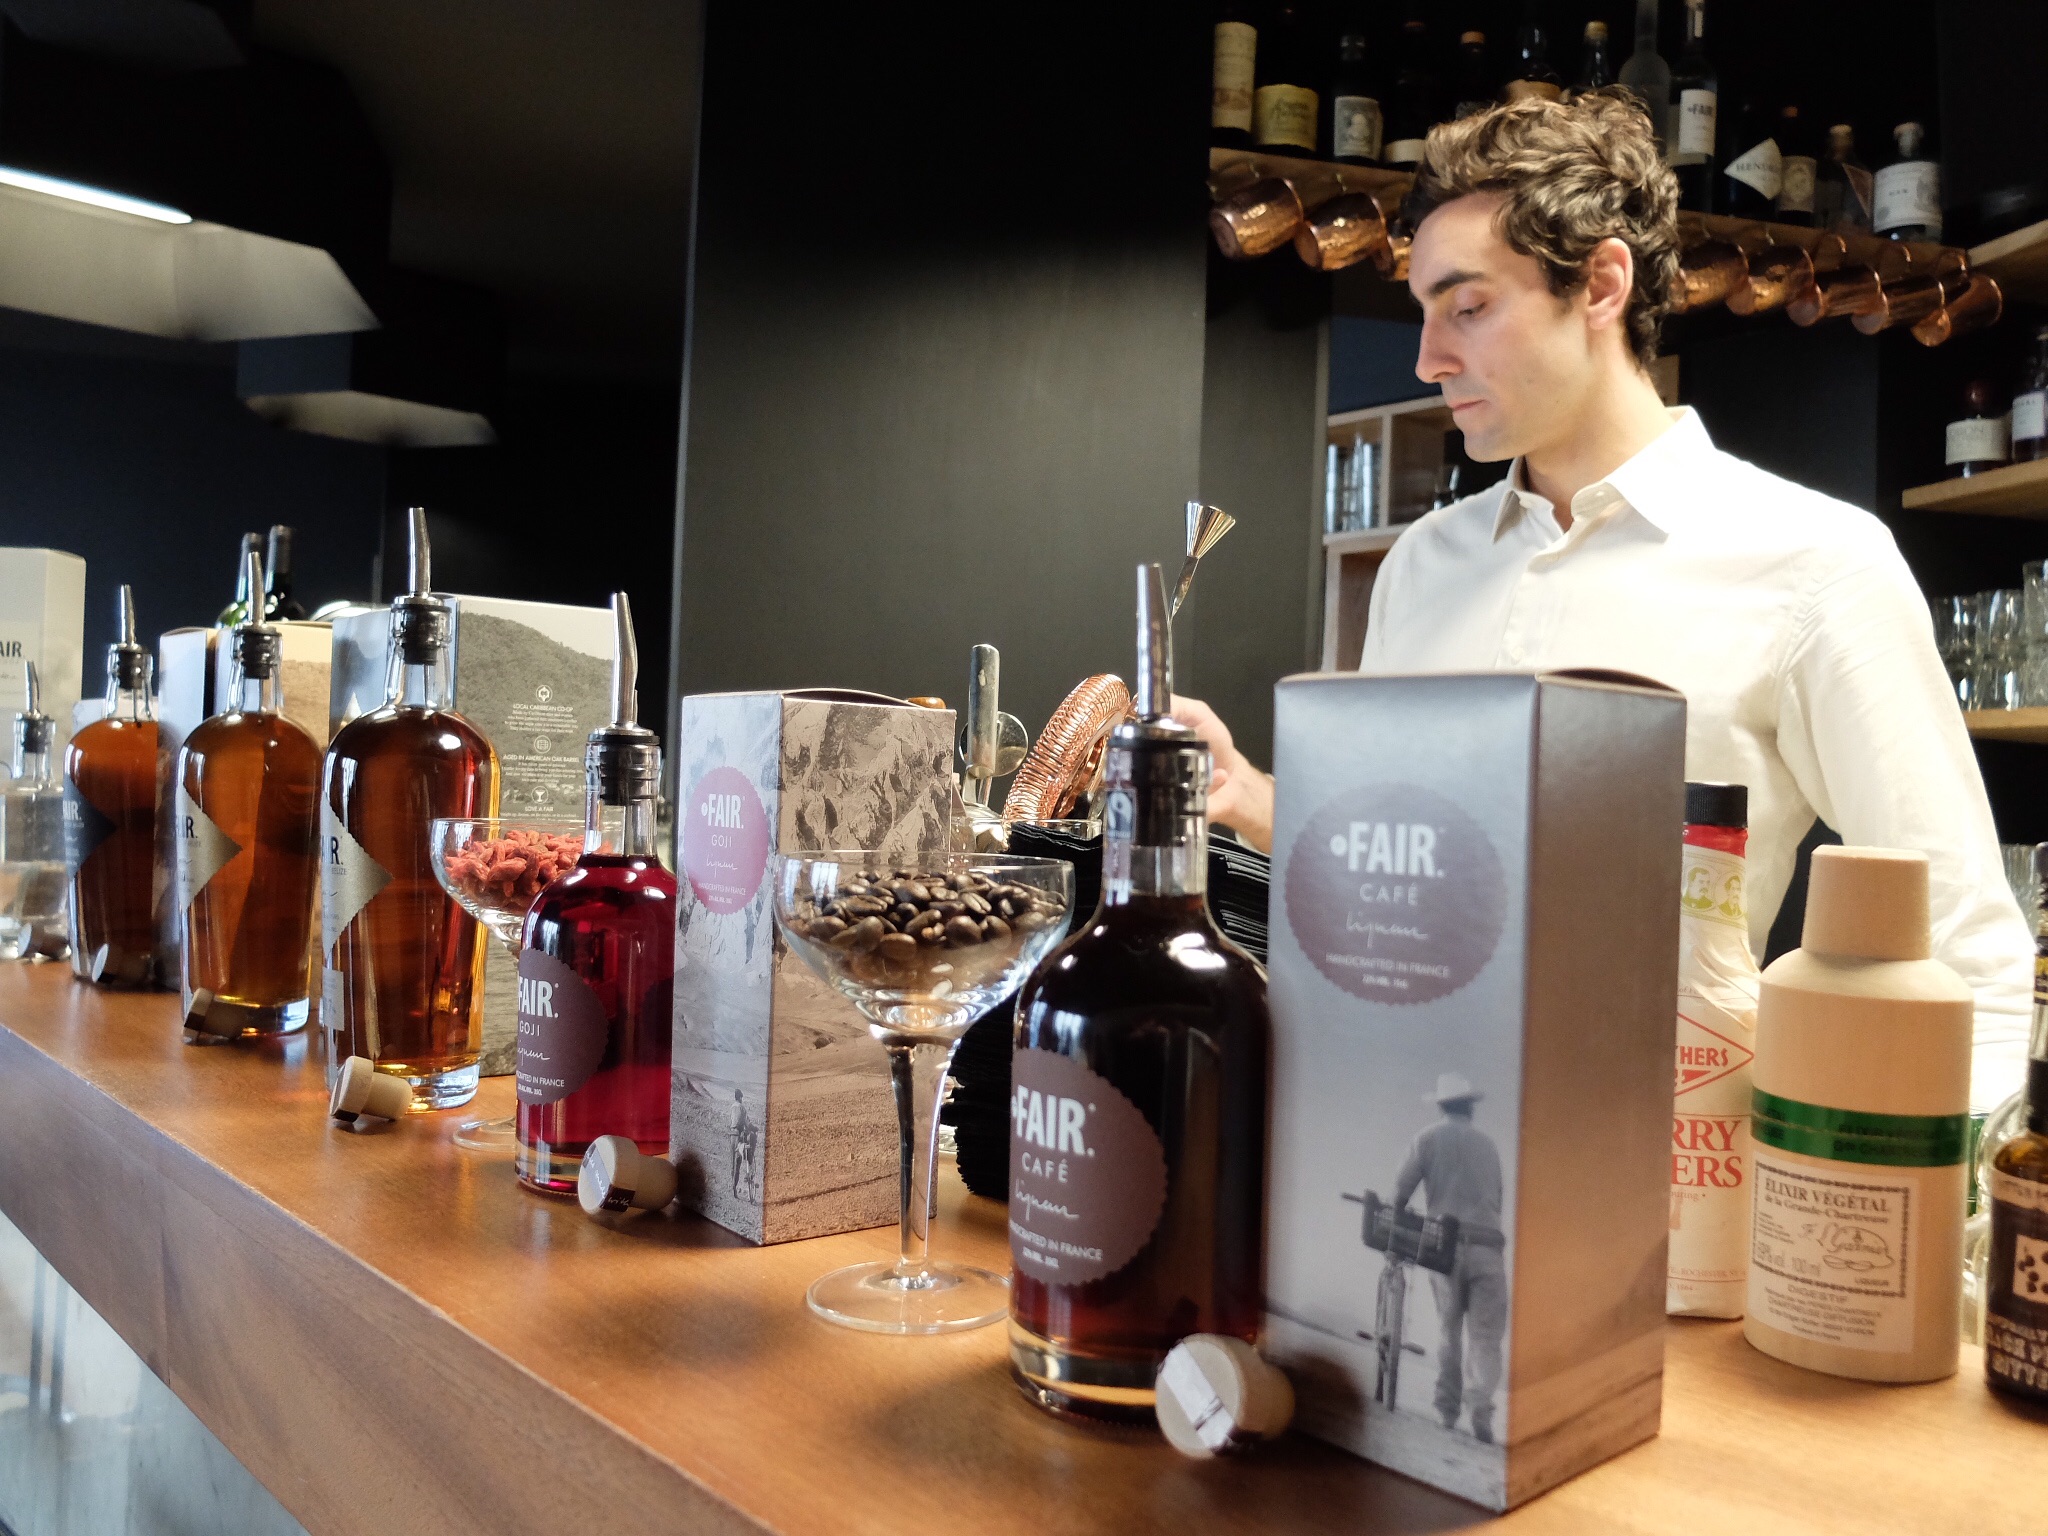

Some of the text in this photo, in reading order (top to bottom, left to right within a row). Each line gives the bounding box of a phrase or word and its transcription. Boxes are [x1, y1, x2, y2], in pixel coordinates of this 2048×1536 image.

[711, 834, 732, 848] GOJI
[1359, 882, 1418, 906] CAFÉ
[1326, 952, 1396, 972] HANDCRAFTED
[1409, 962, 1451, 978] FRANCE
[519, 1020, 540, 1036] GOJI
[1676, 1045, 1728, 1067] HERS
[540, 1077, 565, 1087] FRANCE
[1021, 1152, 1068, 1183] CAFÉ
[1060, 1241, 1104, 1261] FRANCE
